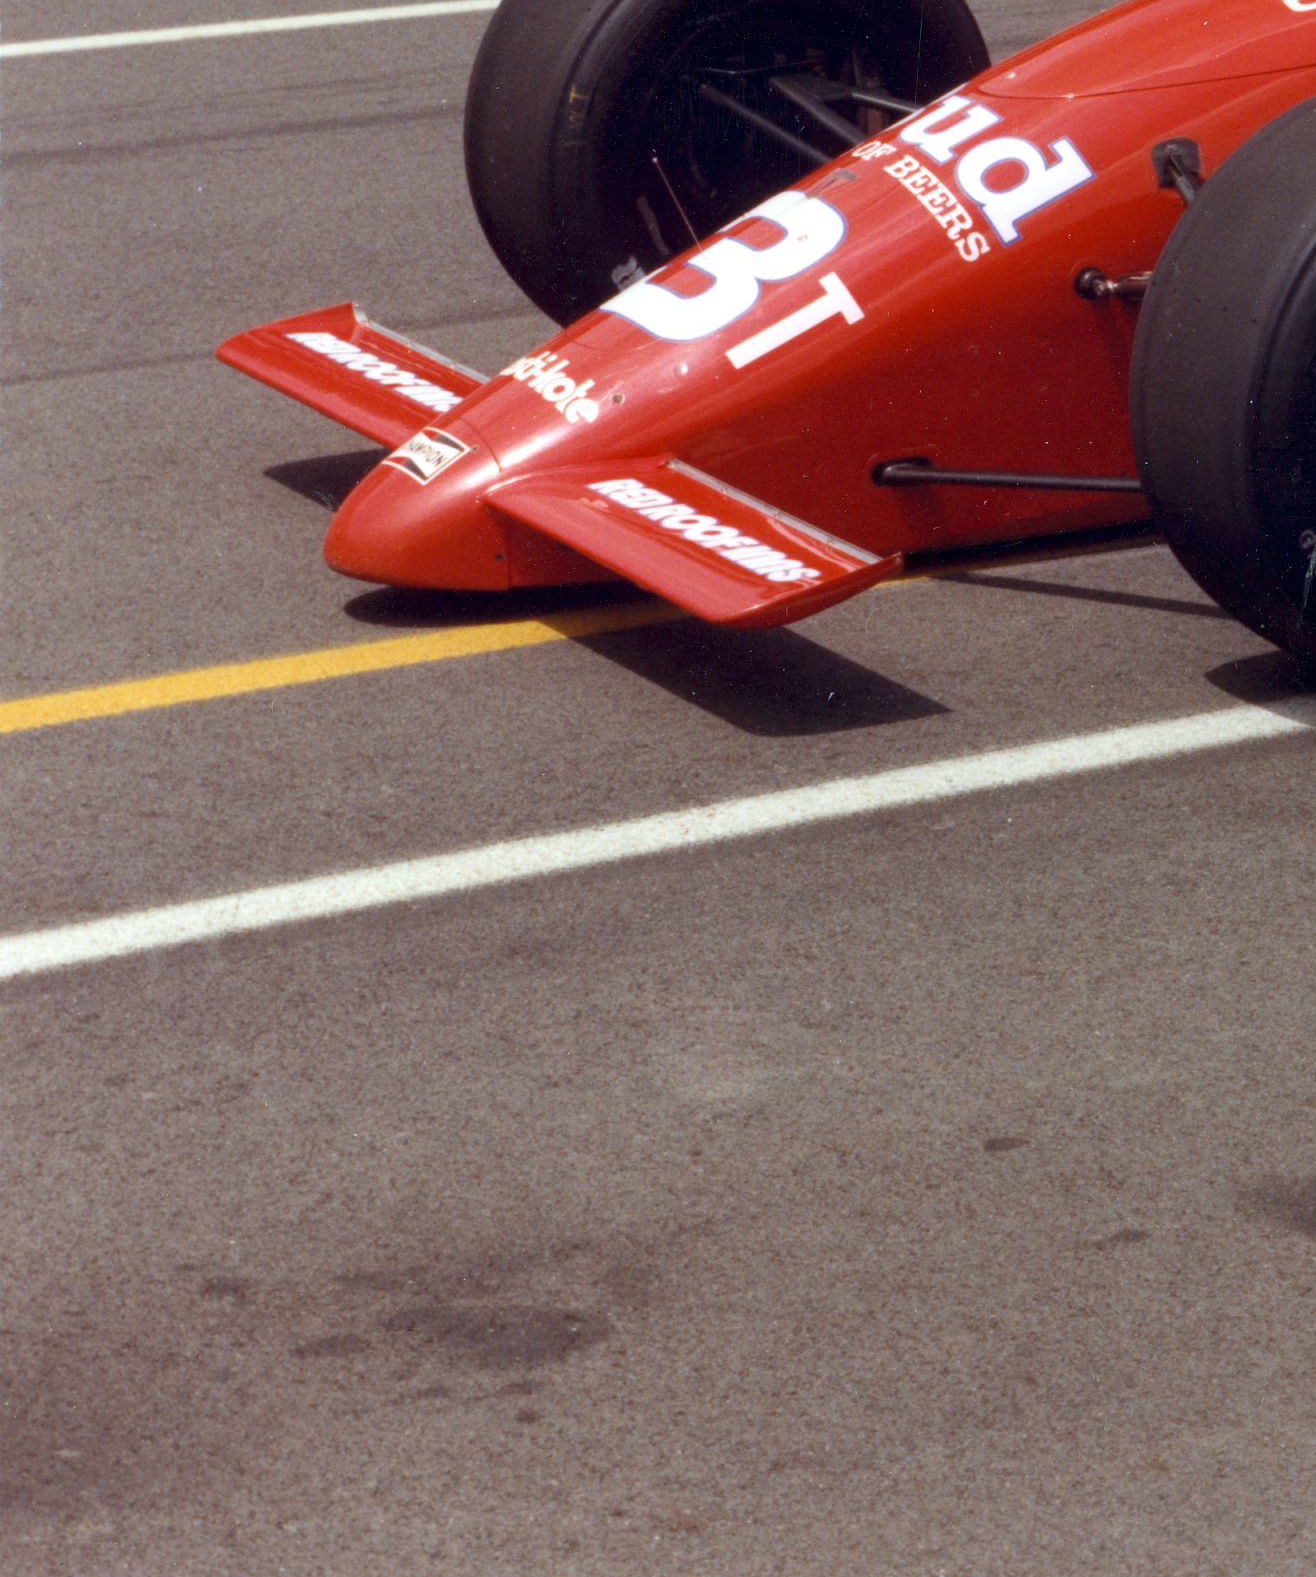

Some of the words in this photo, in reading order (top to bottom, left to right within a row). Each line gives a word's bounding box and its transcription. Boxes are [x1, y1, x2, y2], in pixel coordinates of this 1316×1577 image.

[851, 140, 897, 162] OF
[884, 154, 991, 263] BEERS
[898, 95, 1097, 248] ud
